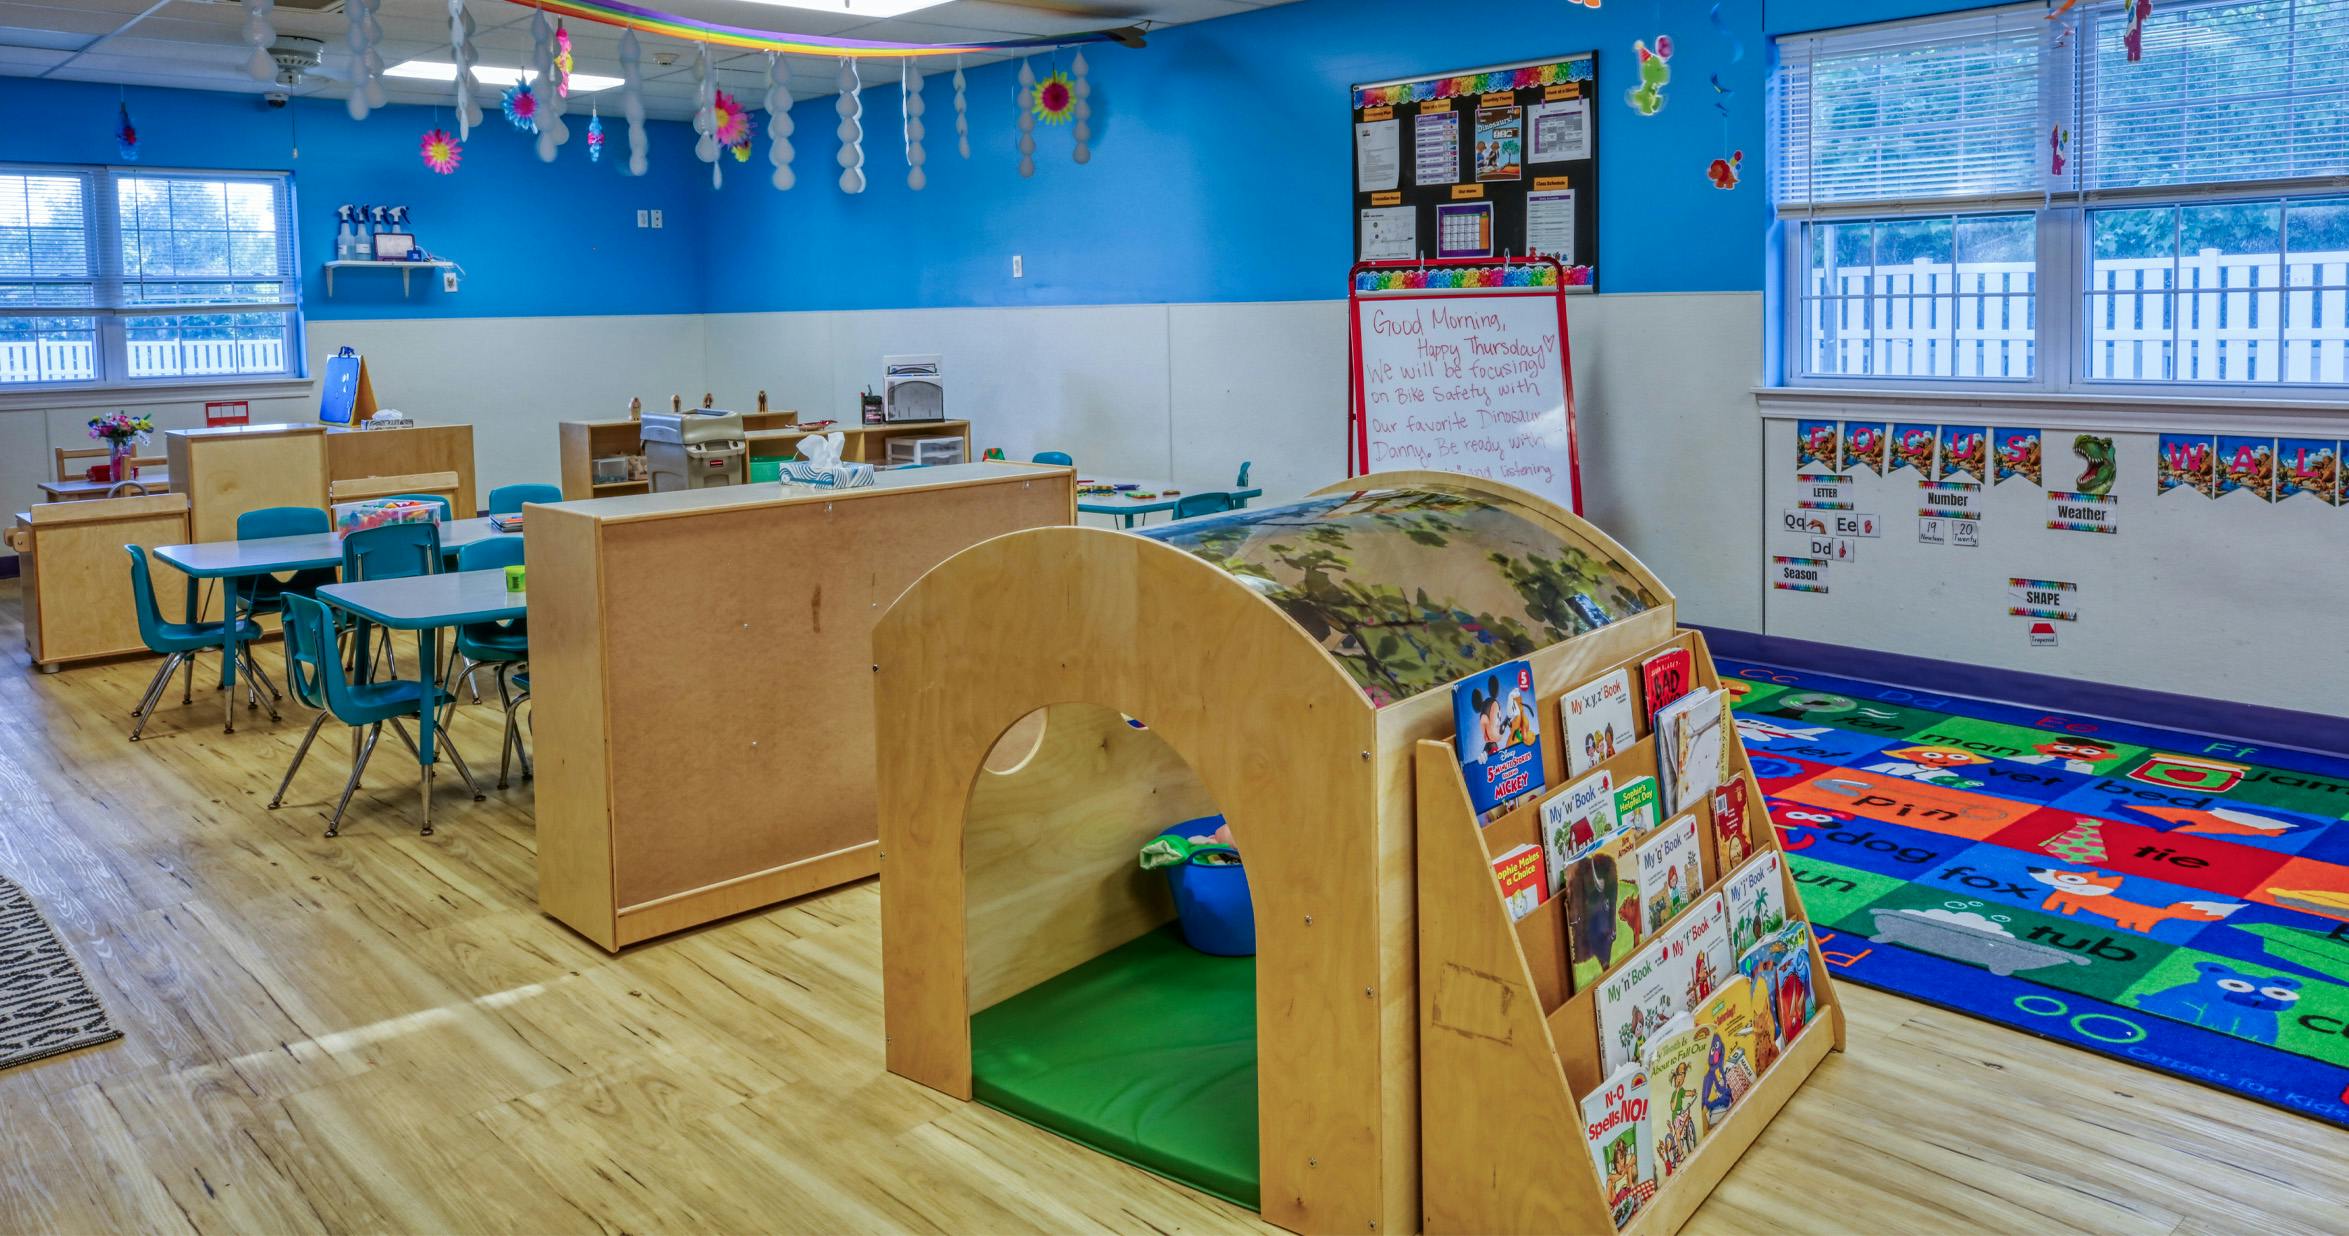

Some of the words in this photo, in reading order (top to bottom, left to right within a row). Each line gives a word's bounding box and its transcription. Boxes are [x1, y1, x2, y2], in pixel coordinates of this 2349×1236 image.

[1374, 308, 1424, 336] Good
[1432, 306, 1506, 332] Morning,
[1418, 338, 1460, 364] Happy
[1464, 335, 1546, 370] Thursday
[1367, 358, 1393, 383] We
[1400, 361, 1434, 380] will
[1445, 361, 1463, 379] be
[1470, 358, 1540, 379] focusing
[1371, 391, 1389, 404] on
[1395, 386, 1425, 405] Bike
[1433, 383, 1492, 405] Safety
[1499, 378, 1541, 397] with
[1406, 411, 1469, 433] favorite
[1434, 436, 1459, 458] Be
[1464, 436, 1505, 461] ready
[1508, 432, 1547, 450] with
[1813, 486, 1838, 499] LETTER
[1927, 491, 1969, 507] Number
[1785, 514, 1805, 531] Qq
[1837, 517, 1857, 532] Ee
[2057, 504, 2108, 522] Weather
[1927, 521, 1937, 533] 19
[1960, 523, 1973, 535] 20
[1812, 541, 1832, 556] Dd
[1784, 567, 1818, 581] Season
[2026, 590, 2061, 606] SHAPE
[1521, 672, 1528, 685] 5
[1739, 668, 1799, 683] Cc
[1571, 699, 1583, 715] My
[1603, 679, 1622, 699] Book
[1919, 733, 2023, 756] man
[1494, 771, 1528, 800] MICKEY
[1987, 764, 2064, 786] vet
[1549, 806, 1563, 825] My
[1575, 785, 1597, 808] Book
[2094, 778, 2215, 809] bed
[1852, 795, 1959, 822] pin
[1644, 852, 1656, 870] My
[1664, 834, 1682, 855] Book
[1826, 831, 1937, 864] dog
[2134, 845, 2209, 869] tie
[1497, 862, 1518, 881] ophie
[1506, 877, 1512, 886] a
[1789, 866, 1857, 893] un
[1937, 865, 2038, 899] fox
[1730, 884, 1741, 902] My
[1749, 868, 1765, 886] Book
[1672, 941, 1684, 958] My
[1692, 916, 1710, 941] Book
[2026, 924, 2138, 962] tub
[1607, 984, 1621, 1004] My
[1631, 960, 1653, 986] Book
[1678, 1046, 1691, 1061] Fall
[1605, 1084, 1624, 1108] N-O
[1620, 1098, 1648, 1123] NO!
